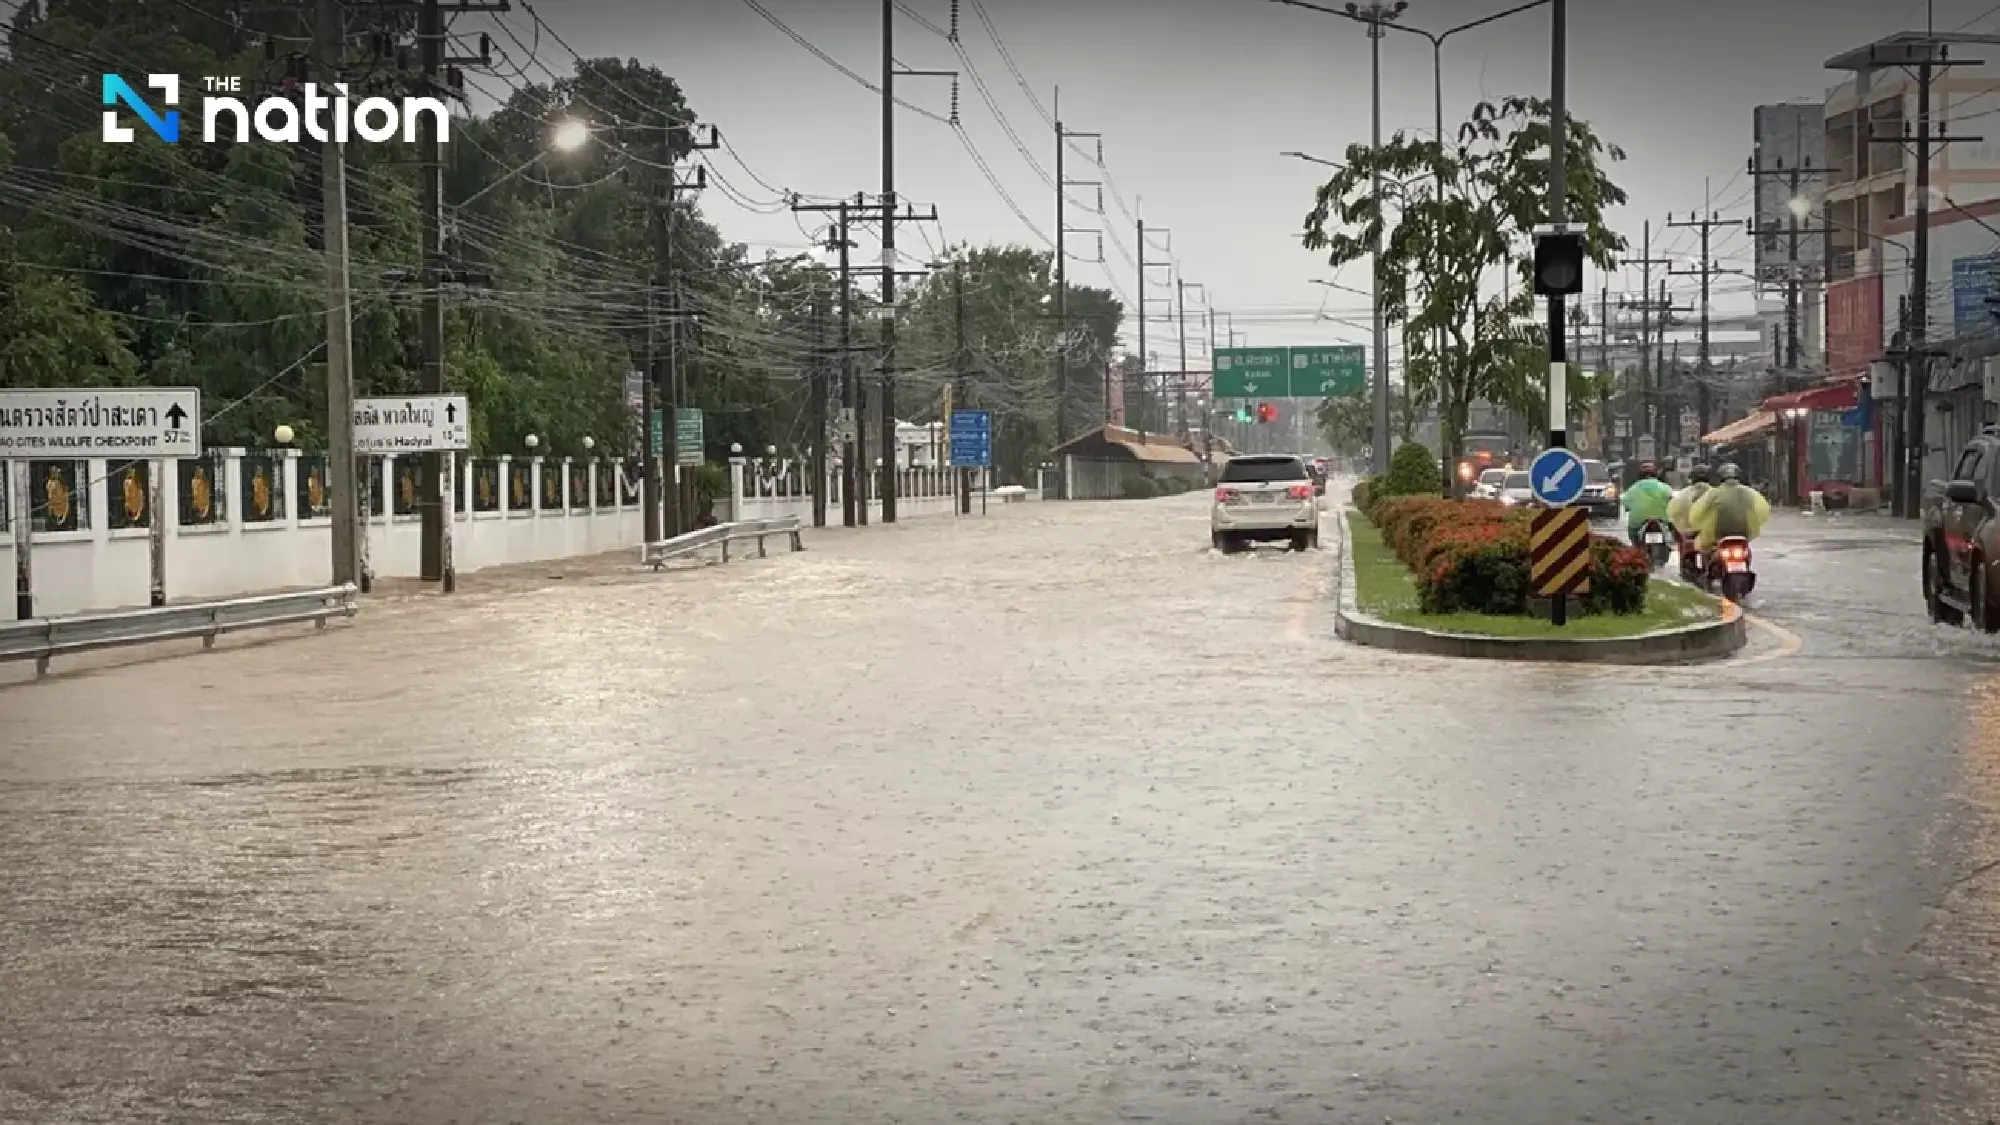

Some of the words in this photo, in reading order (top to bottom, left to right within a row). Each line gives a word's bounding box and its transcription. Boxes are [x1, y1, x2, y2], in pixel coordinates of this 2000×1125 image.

[16, 435, 45, 448] CITES
[48, 435, 92, 448] WILDLIFE
[95, 435, 158, 448] CHECKPOINT
[164, 429, 178, 444] 57
